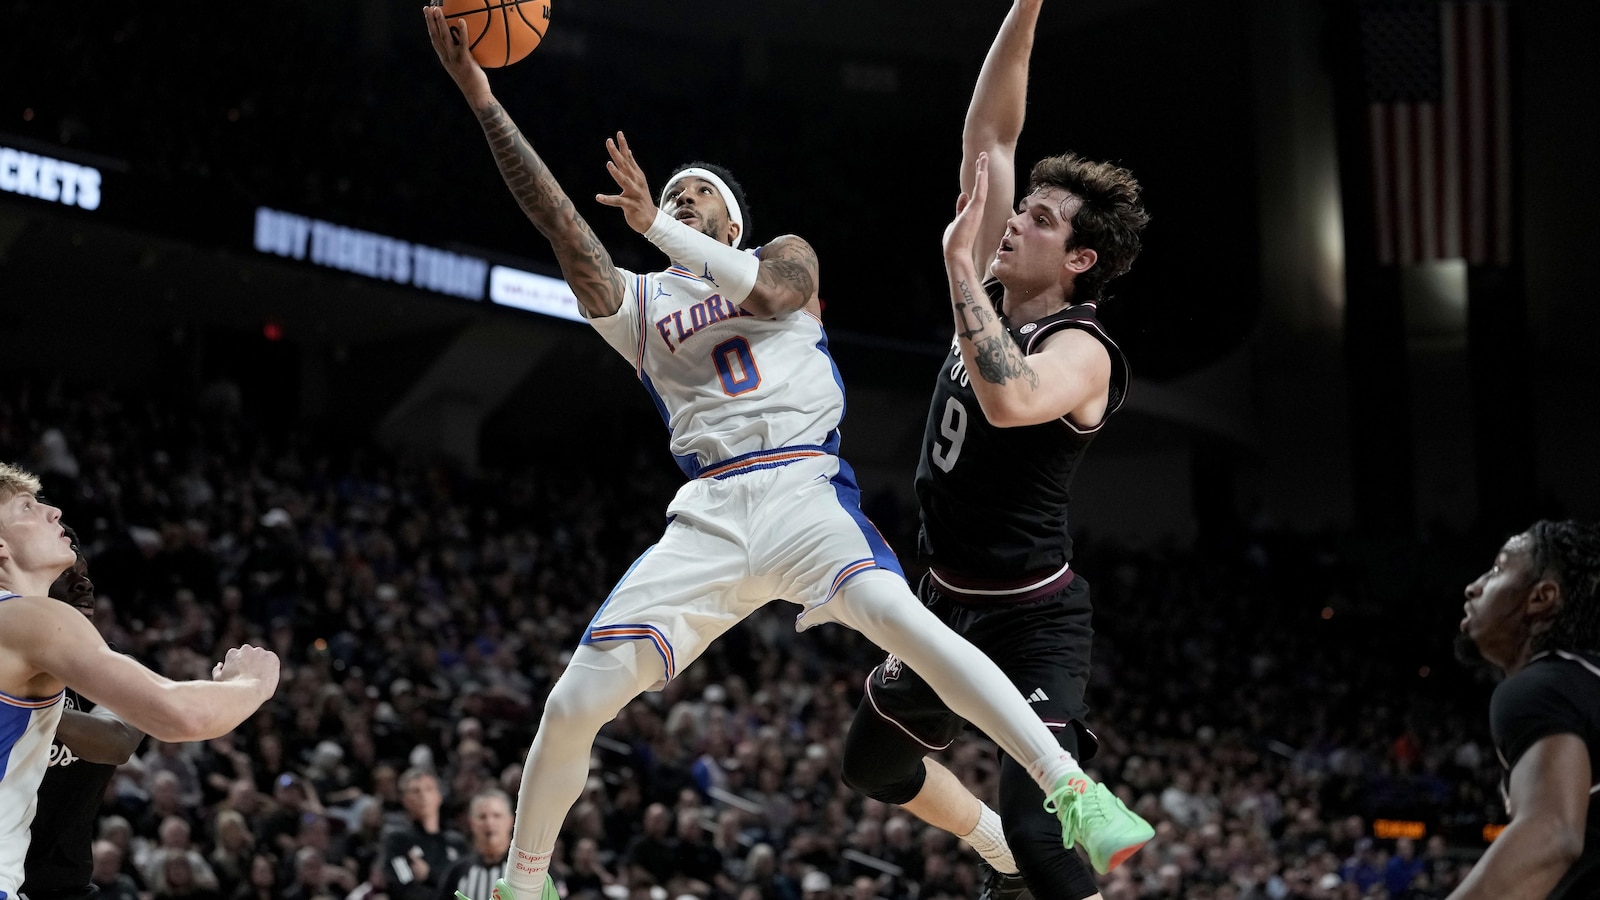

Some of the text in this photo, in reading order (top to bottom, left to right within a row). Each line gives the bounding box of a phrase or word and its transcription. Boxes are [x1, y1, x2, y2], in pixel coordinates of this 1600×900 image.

[254, 206, 310, 261] BUY
[311, 219, 411, 284] TICKETS
[656, 294, 774, 354] FLORI
[711, 335, 762, 397] 0
[932, 396, 968, 473] 9
